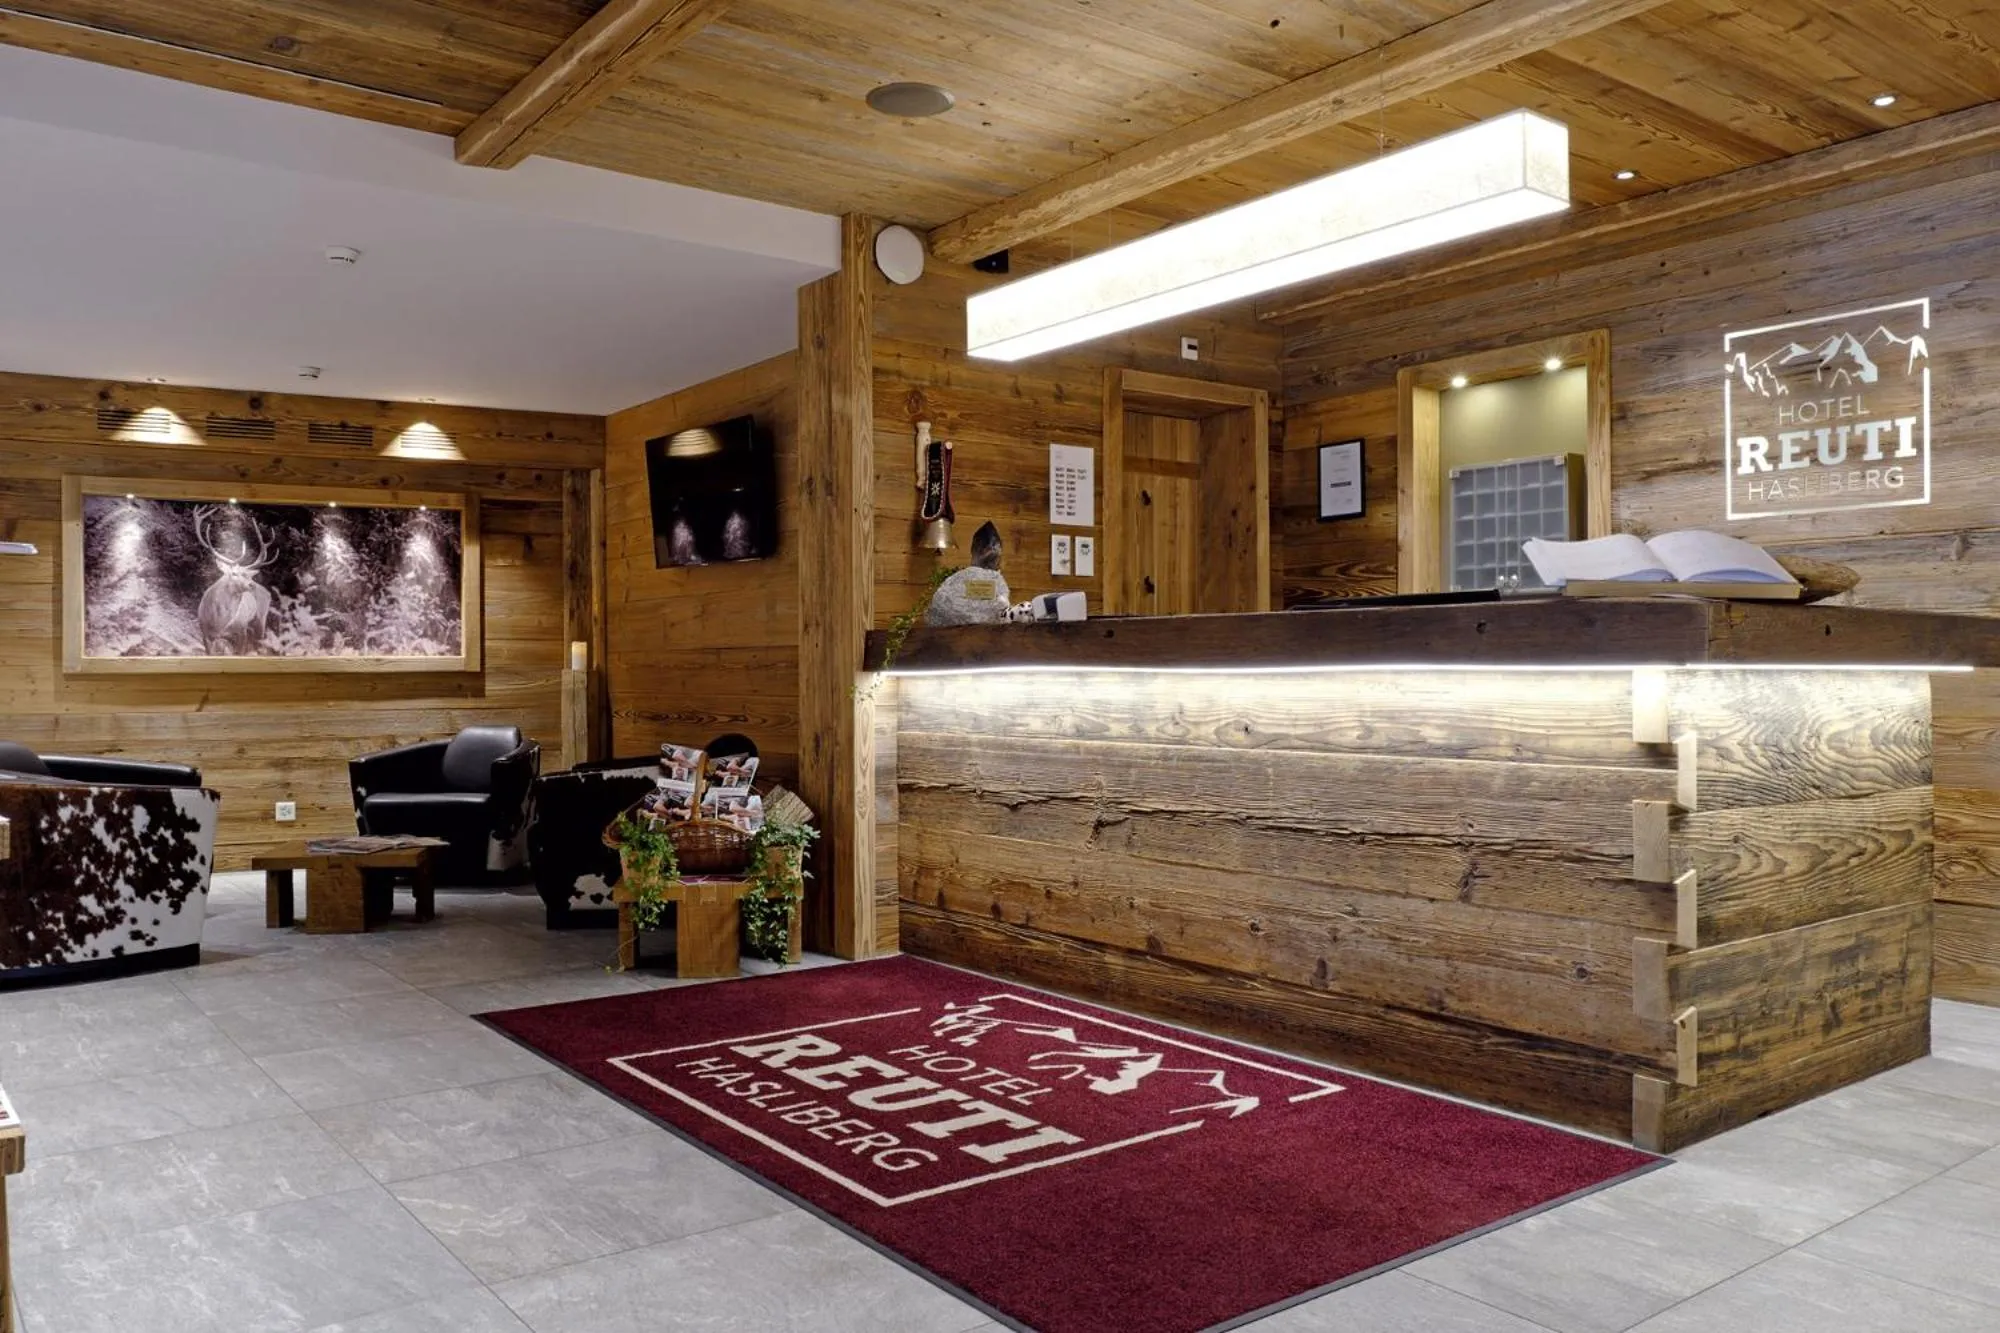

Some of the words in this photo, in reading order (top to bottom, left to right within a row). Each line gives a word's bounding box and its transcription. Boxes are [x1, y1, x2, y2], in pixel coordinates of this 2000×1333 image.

[1779, 394, 1870, 424] HOTEL
[1736, 416, 1917, 475] REUTI
[1748, 467, 1904, 501] HASLIBERG
[729, 1034, 1085, 1164] REUTI
[888, 1045, 1052, 1106] HOTEL
[676, 1057, 938, 1172] HASLIBERG
